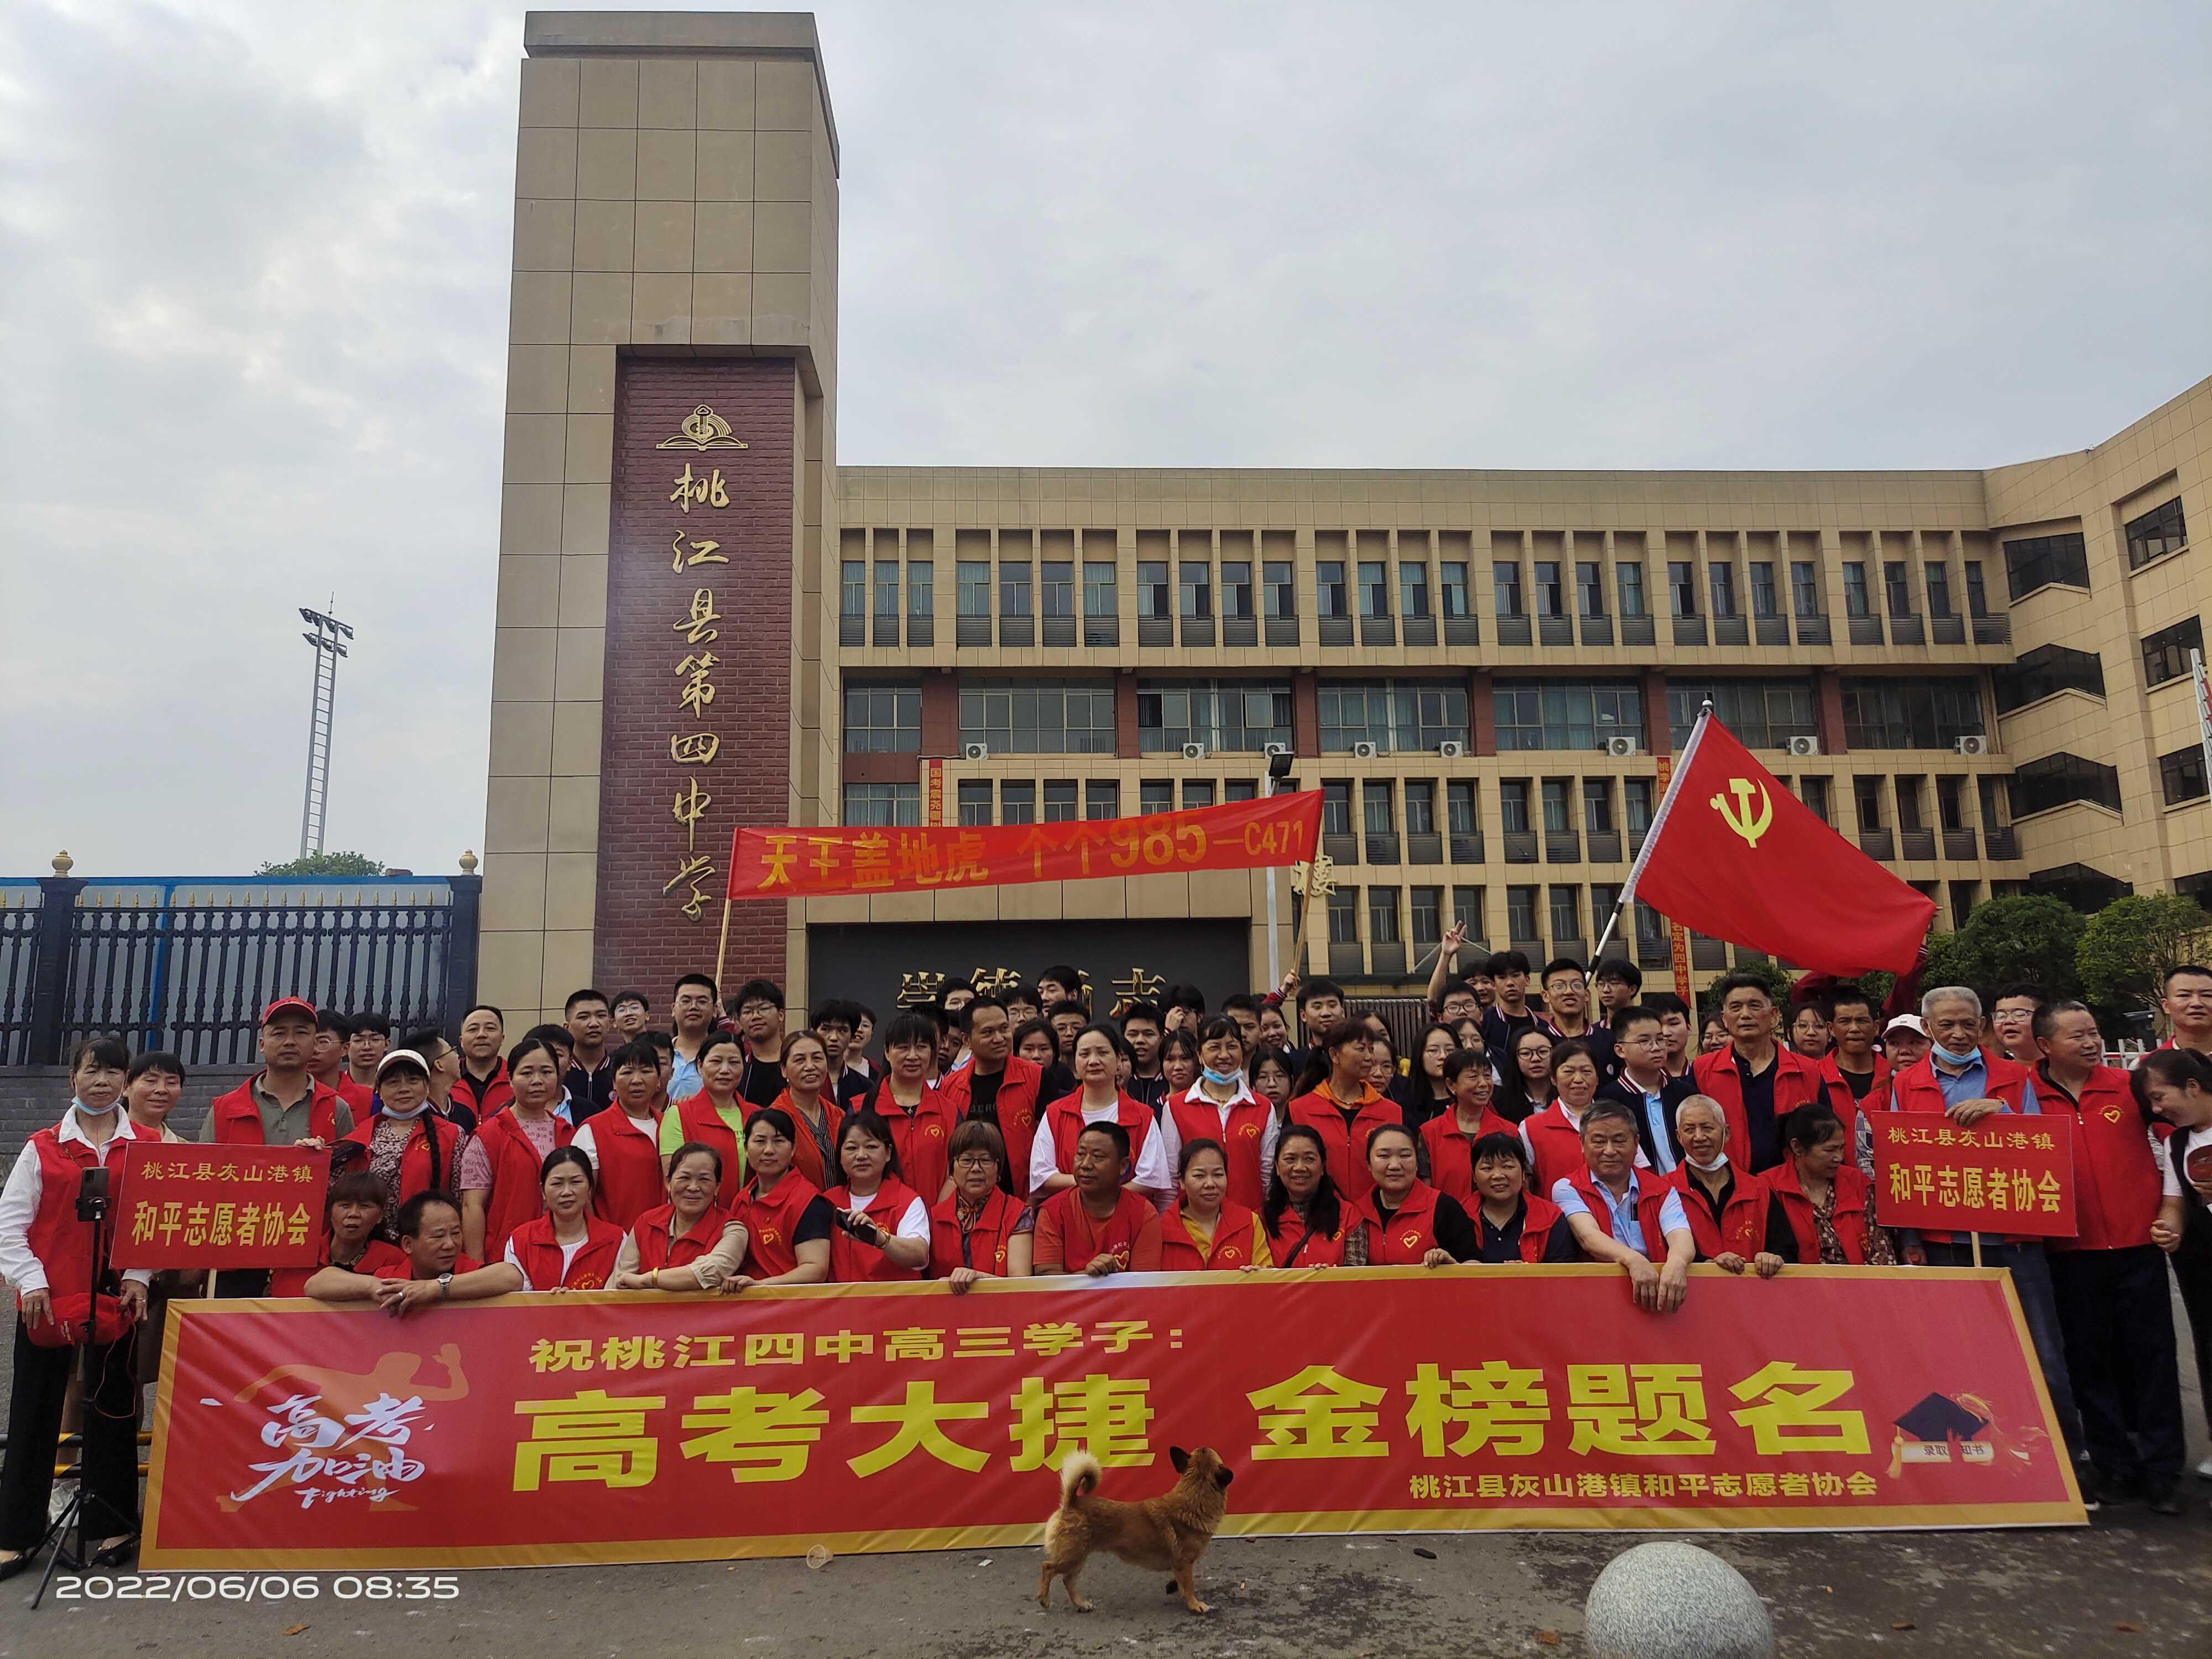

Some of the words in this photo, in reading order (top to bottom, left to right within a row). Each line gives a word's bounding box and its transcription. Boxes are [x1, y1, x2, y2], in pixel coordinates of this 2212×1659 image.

[663, 463, 729, 922] 桃江县第四中学
[757, 831, 989, 891] 天王盖地虎
[1888, 1126, 2055, 1151] 桃江县灰山港镇
[141, 1160, 314, 1183] 桃江县灰山港镇
[1890, 1163, 2061, 1213] 和平志愿者协会
[132, 1200, 310, 1246] 和平志愿者协会
[260, 1392, 426, 1451] 高考
[512, 1374, 1156, 1492] 高考大捷
[1246, 1360, 1872, 1461] 金榜题名
[231, 1447, 425, 1501] 加油
[1409, 1471, 1877, 1499] 桃江县灰山港镇和平志愿者协会
